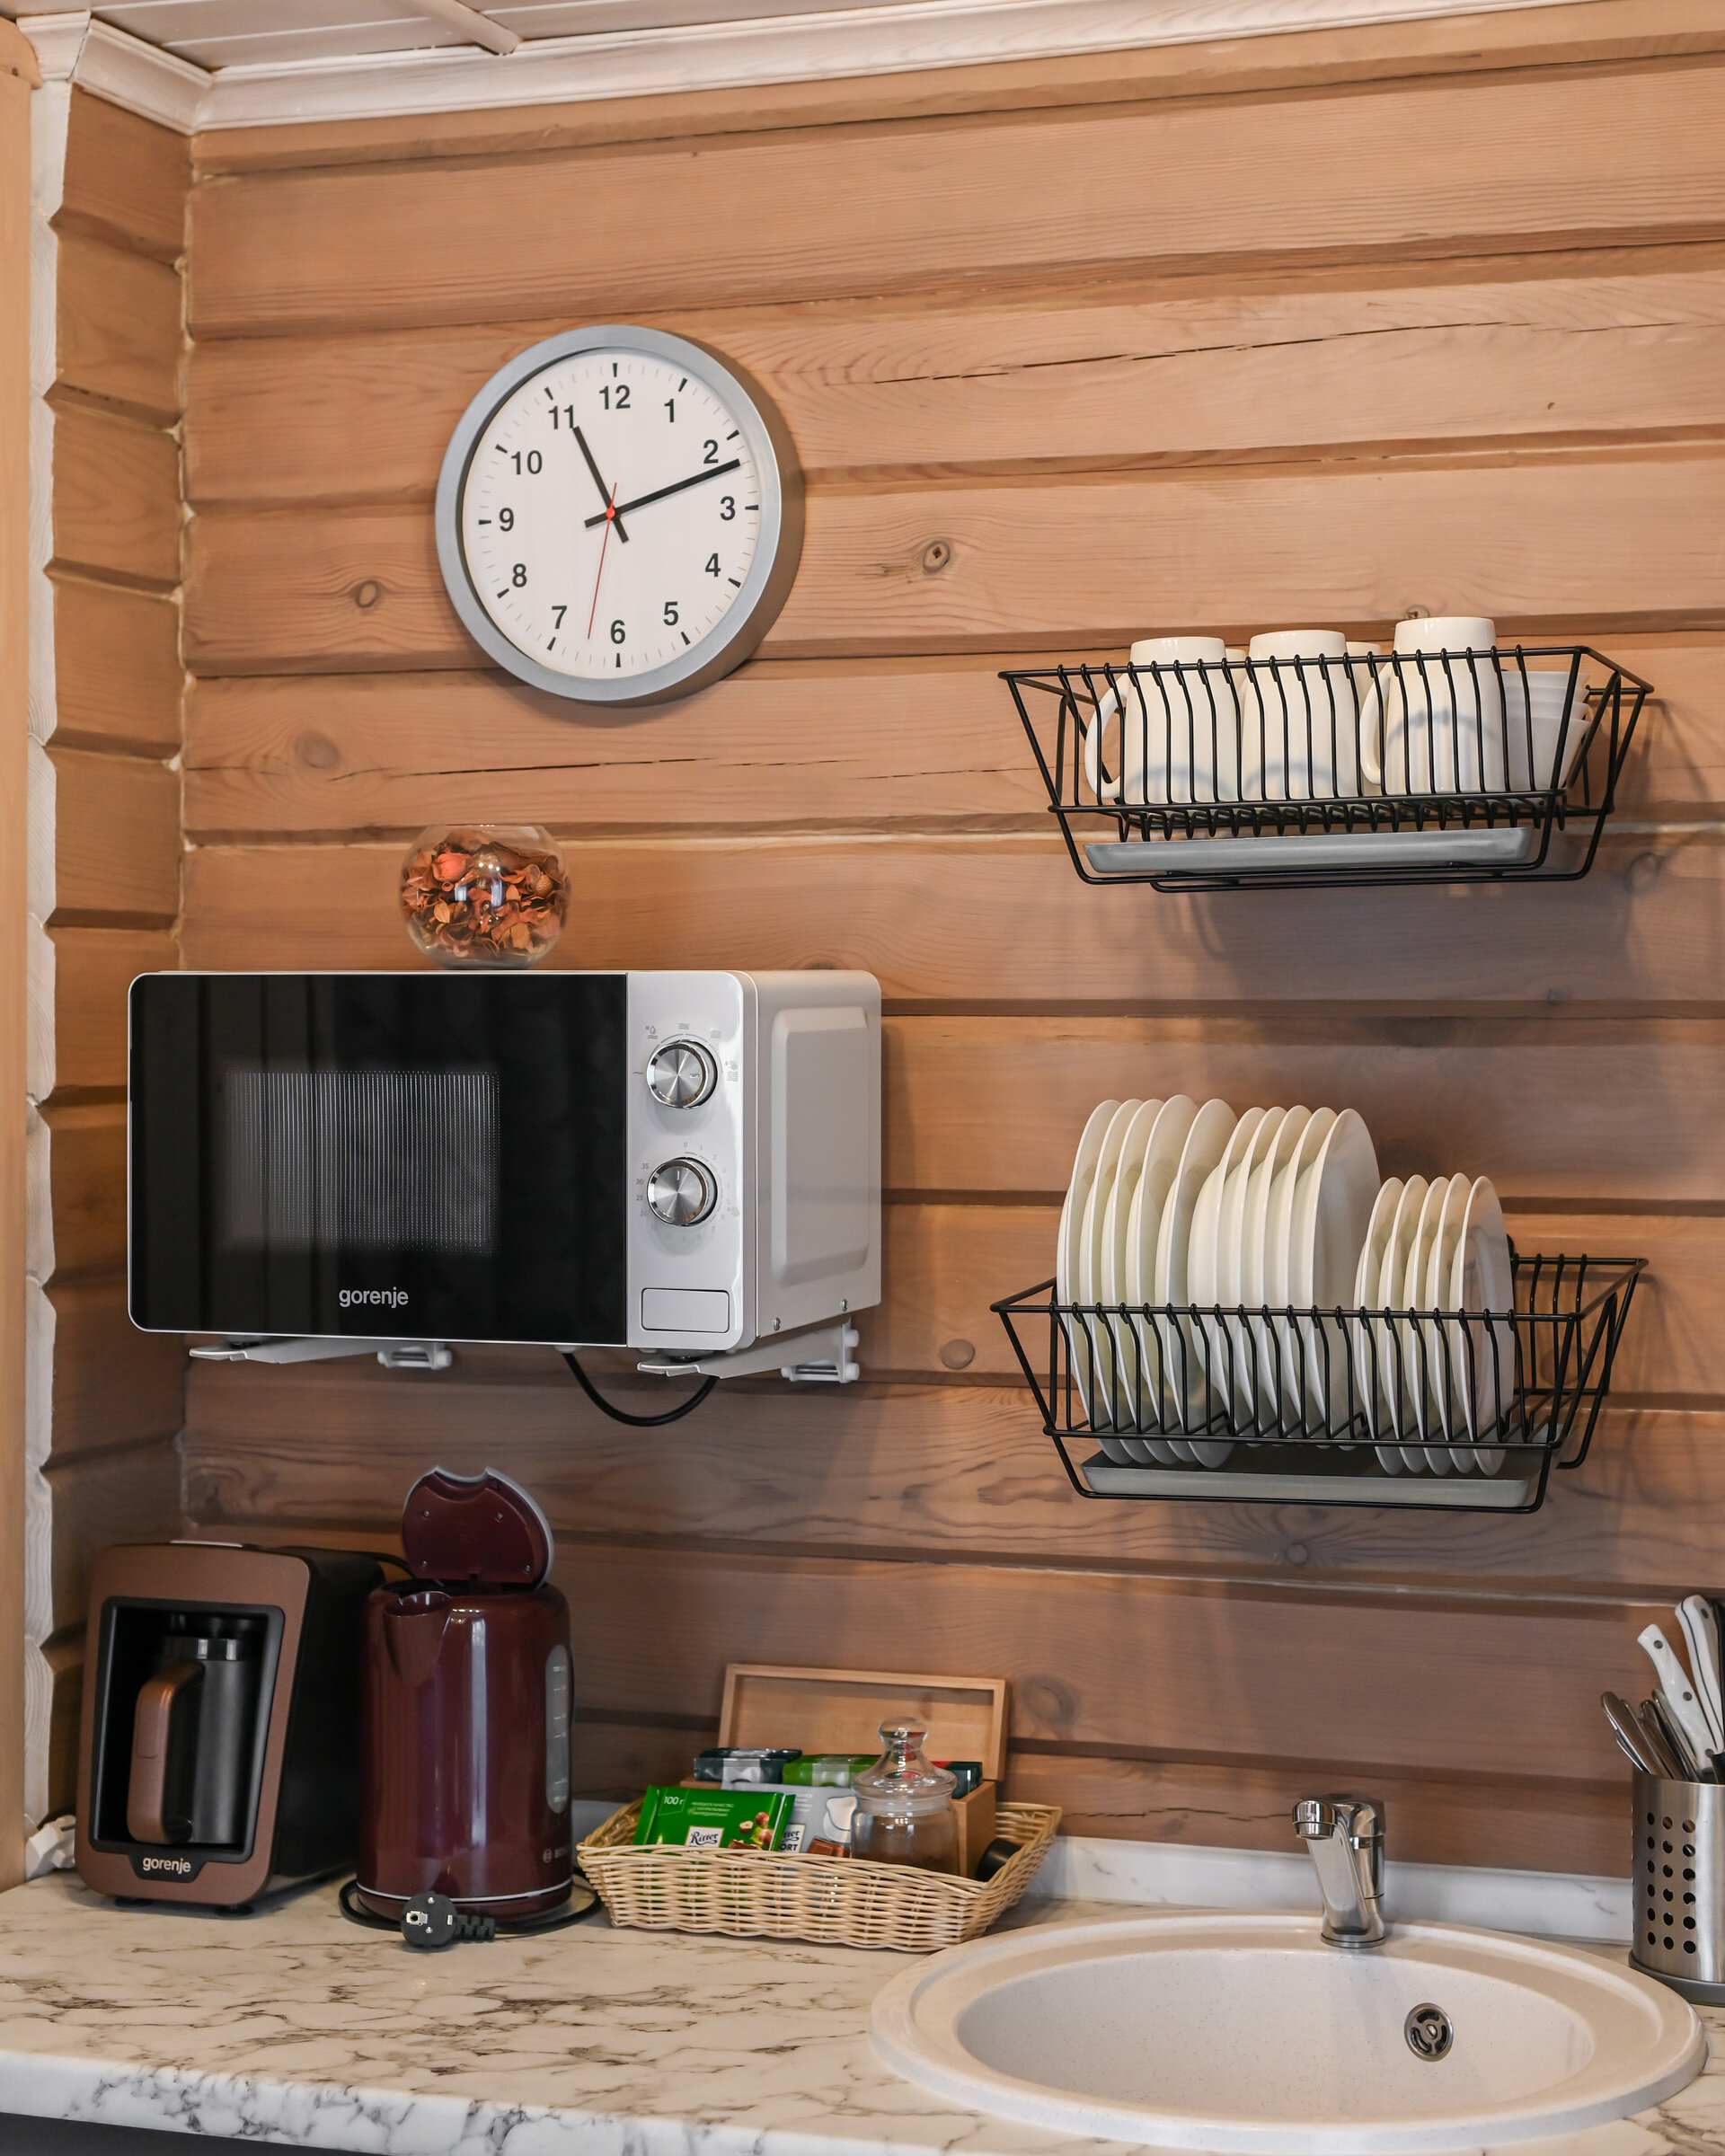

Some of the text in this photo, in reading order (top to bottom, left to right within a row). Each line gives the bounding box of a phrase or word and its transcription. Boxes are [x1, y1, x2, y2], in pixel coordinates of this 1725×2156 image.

[598, 384, 631, 411] 12
[548, 404, 575, 429] 11
[664, 398, 675, 423] 1
[510, 449, 543, 475] 10
[703, 438, 719, 464] 2
[499, 507, 515, 533] 9
[720, 495, 736, 521] 3
[511, 562, 527, 588] 8
[704, 552, 721, 578] 4
[551, 605, 568, 630] 7
[663, 601, 679, 626] 5
[610, 619, 626, 645] 6
[339, 1286, 409, 1308] gorenje
[664, 1797, 678, 1805] 100
[690, 1832, 719, 1845] Ritter
[780, 1843, 798, 1851] ORT
[143, 1857, 191, 1875] gorenje
